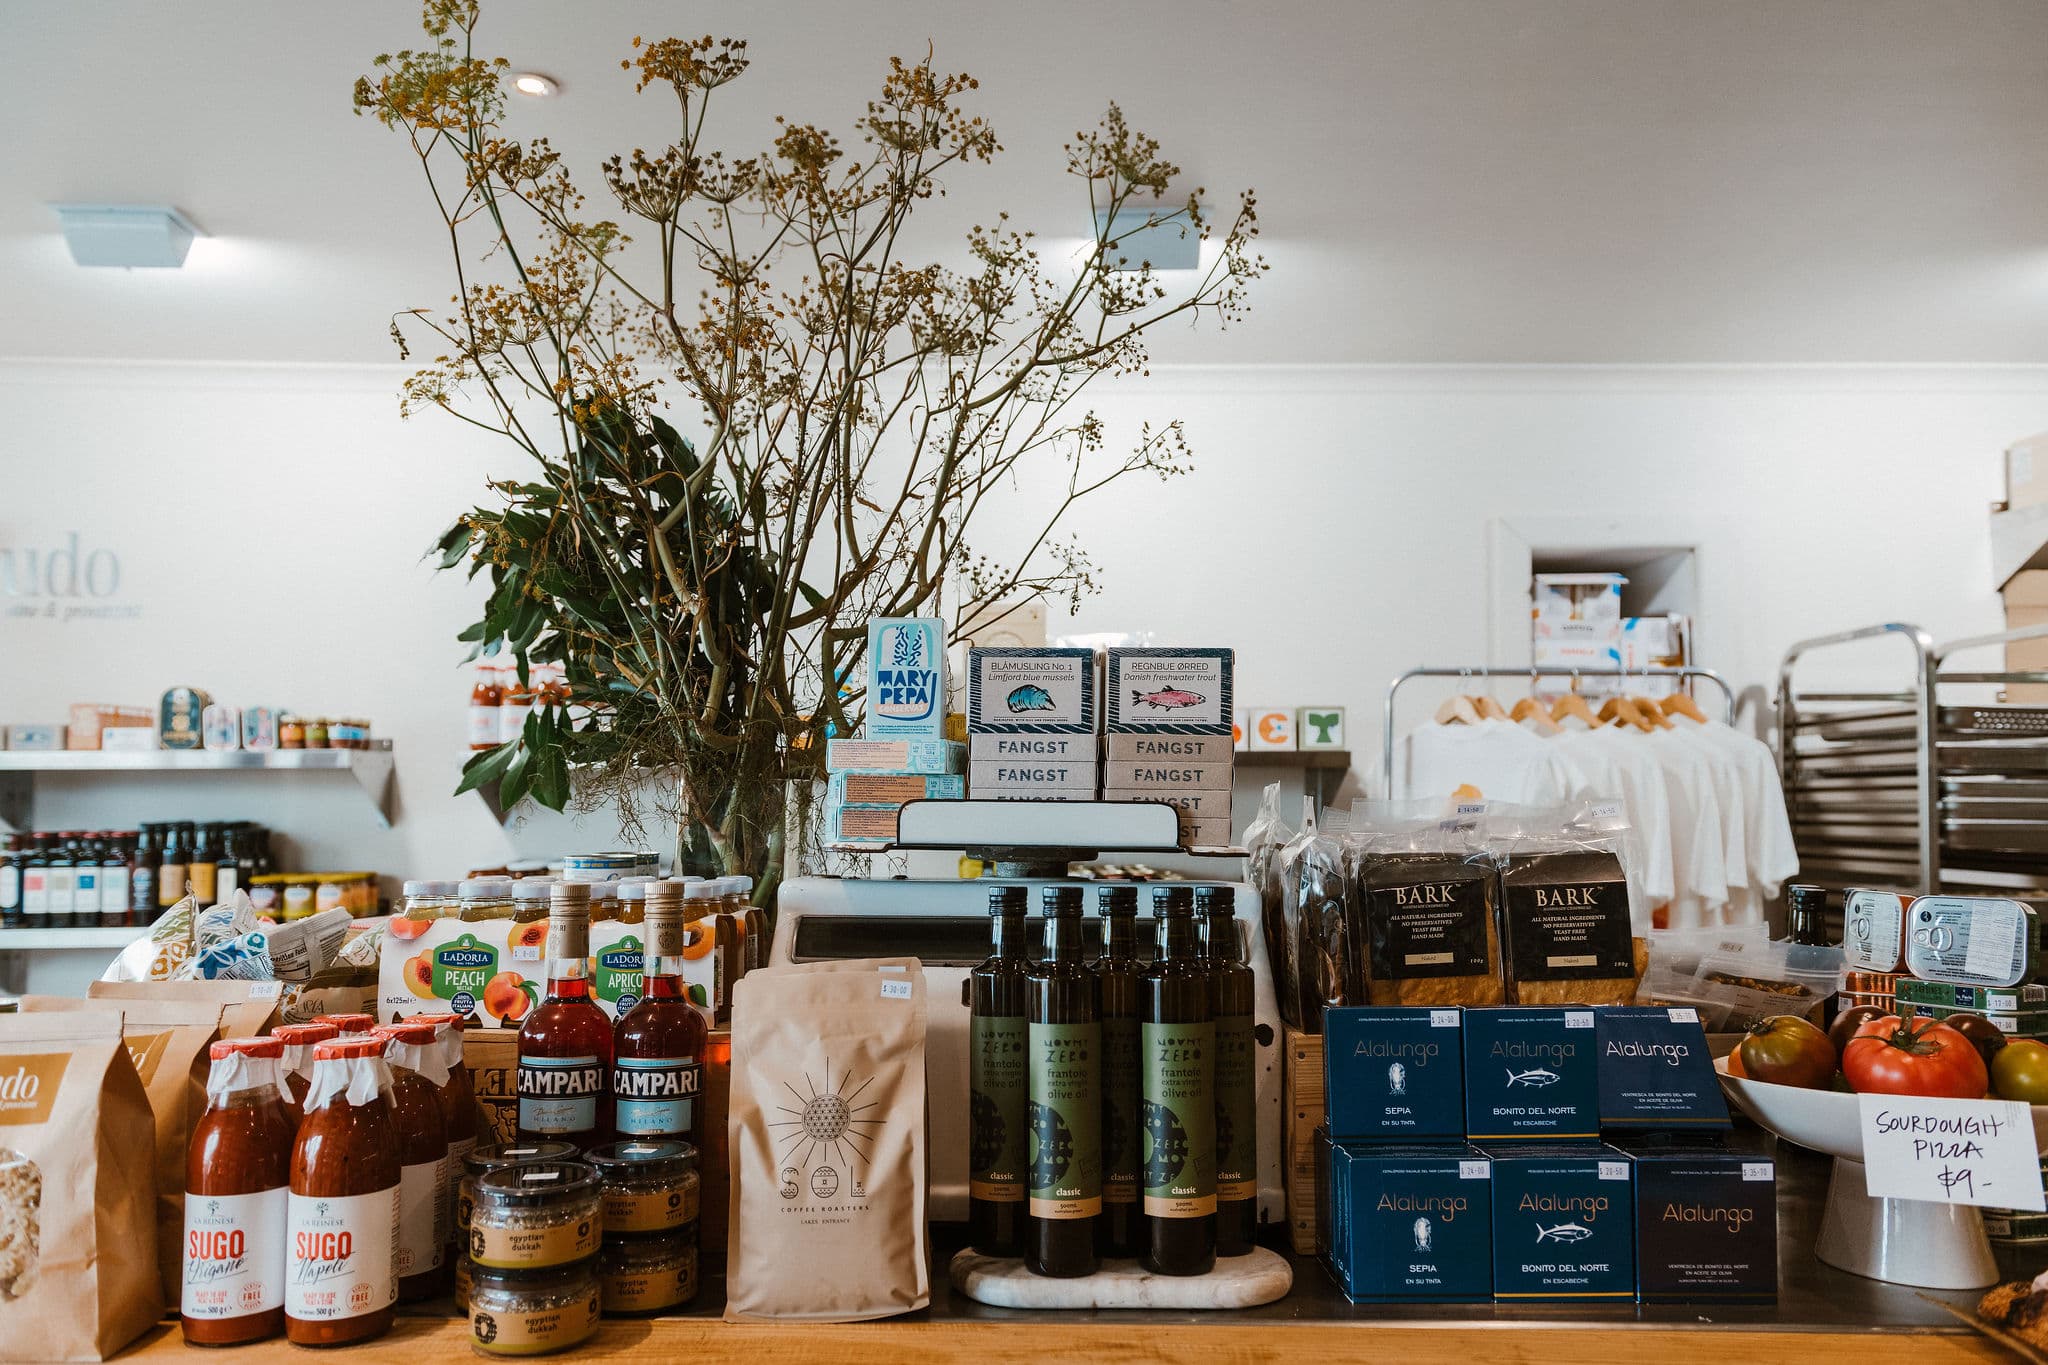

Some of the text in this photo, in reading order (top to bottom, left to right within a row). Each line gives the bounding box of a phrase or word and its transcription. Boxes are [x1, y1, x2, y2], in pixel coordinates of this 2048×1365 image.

[991, 661, 1050, 670] BLÅMUSLING
[1131, 662, 1209, 671] REGNBUE ØRRED
[878, 670, 932, 687] MARY
[988, 673, 1075, 682] Limfjord blue mussels
[1124, 673, 1217, 682] Danish freshwater trout
[880, 688, 928, 704] PEPA
[999, 741, 1068, 754] FANGST
[1136, 742, 1205, 754] FANGST
[998, 768, 1068, 782] FANGST
[1134, 769, 1203, 782] FANGST
[1396, 885, 1456, 904] BARK
[1535, 887, 1598, 907] BARK
[445, 971, 485, 986] PEACH
[608, 973, 643, 988] APRICO
[1354, 1040, 1439, 1067] Alalunga
[1492, 1041, 1575, 1067] Alalunga
[1606, 1041, 1689, 1066] Alalunga
[1047, 1068, 1088, 1078] frantoio
[517, 1068, 603, 1095] CAMPARI
[613, 1069, 699, 1096] CAMPARI
[1047, 1088, 1087, 1099] olive oil
[1162, 1088, 1187, 1098] olive
[1385, 1107, 1412, 1115] SEPIA
[1528, 1107, 1545, 1115] DEL
[1876, 1110, 2004, 1137] SOURDOUGH
[1914, 1139, 1983, 1160] PIZZA
[780, 1166, 866, 1199] SOL
[990, 1172, 1014, 1180] classic
[1217, 1172, 1241, 1180] classic
[1056, 1187, 1081, 1196] classic
[1171, 1185, 1196, 1194] classic
[1377, 1193, 1467, 1222] Alalunga
[1519, 1193, 1609, 1221] Alalunga
[1663, 1203, 1753, 1232] Alalunga
[509, 1233, 544, 1243] egyptian
[189, 1229, 245, 1261] SUGO
[296, 1231, 352, 1261] SUGO
[512, 1243, 541, 1251] dukkah
[297, 1257, 346, 1285] Napoli
[1409, 1265, 1437, 1273] SEPIA
[1559, 1264, 1576, 1272] DEL
[1580, 1264, 1610, 1272] NORTE
[243, 1292, 261, 1301] FREE
[351, 1292, 369, 1302] FREE
[525, 1314, 560, 1326] egyptian
[528, 1324, 557, 1334] dukkah
